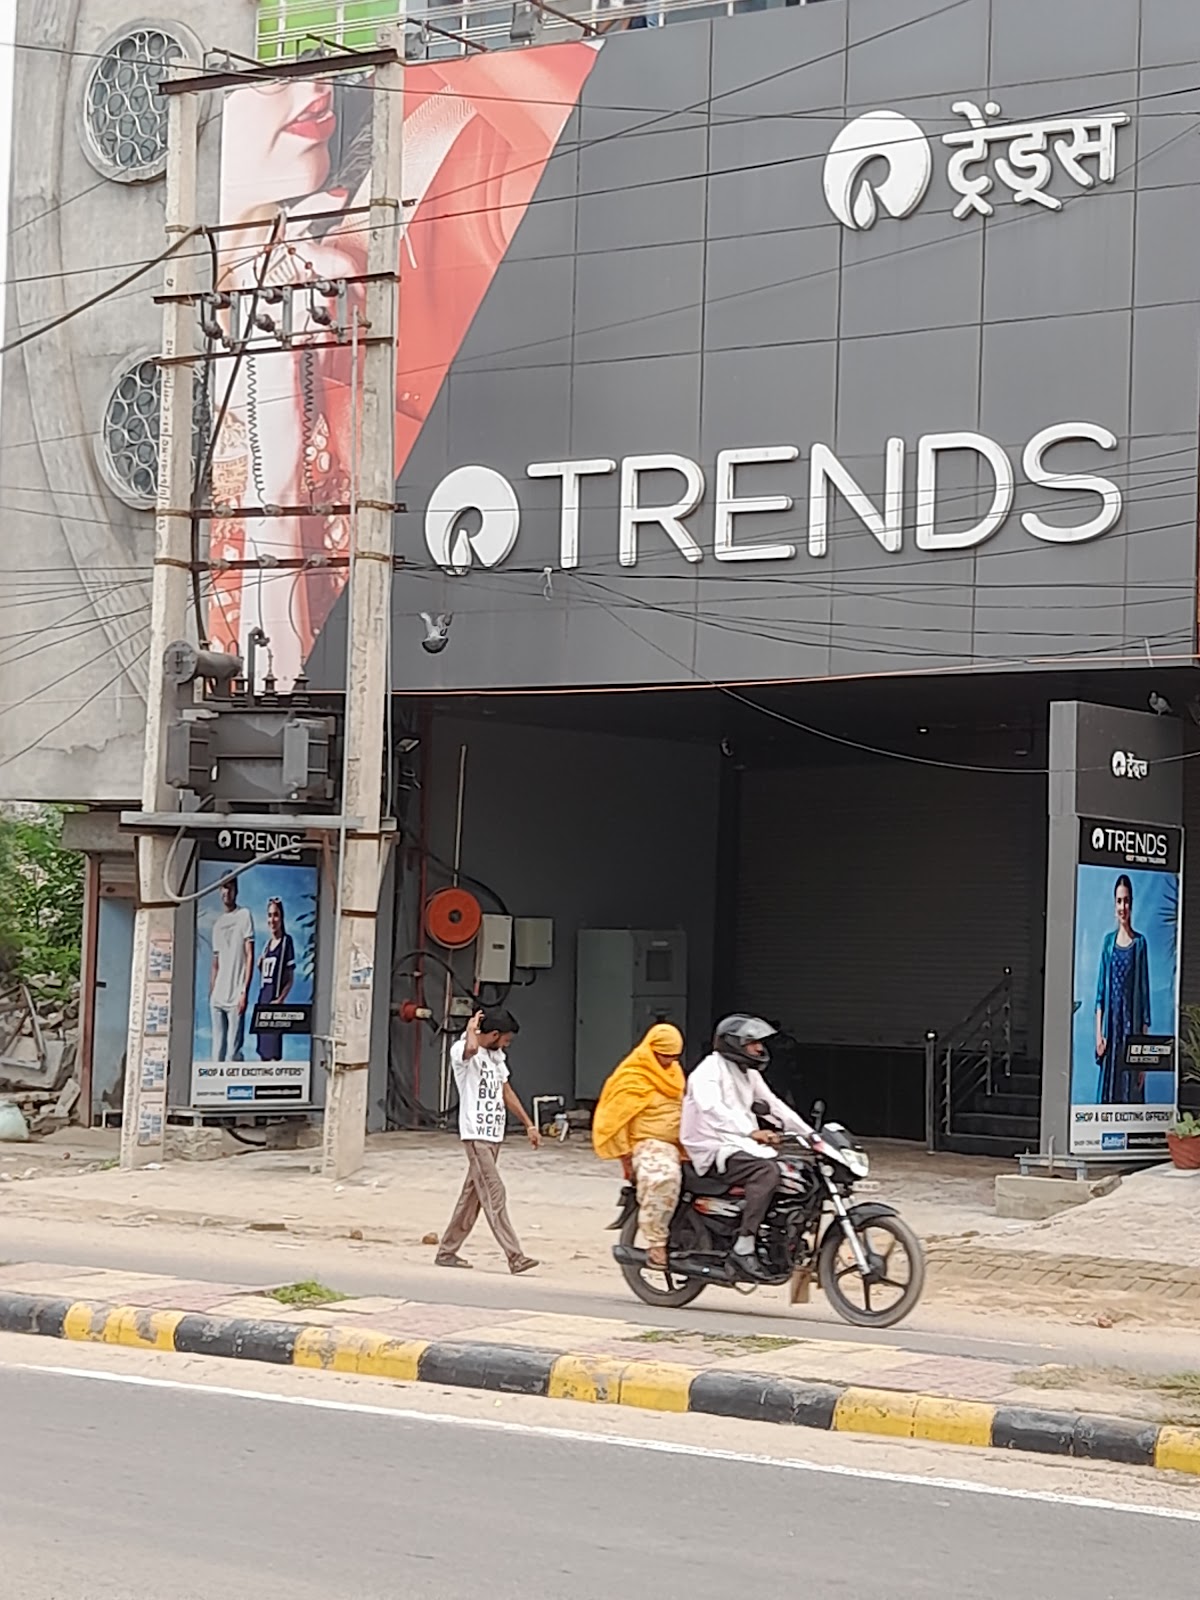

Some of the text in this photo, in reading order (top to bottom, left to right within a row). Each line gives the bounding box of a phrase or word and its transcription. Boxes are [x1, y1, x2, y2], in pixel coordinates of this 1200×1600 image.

[526, 421, 1122, 569] TRENDS
[232, 830, 301, 853] TRENDS
[1105, 829, 1167, 856] TRENDS
[226, 1067, 240, 1077] GET
[478, 1088, 497, 1099] BU
[484, 1101, 505, 1112] CA
